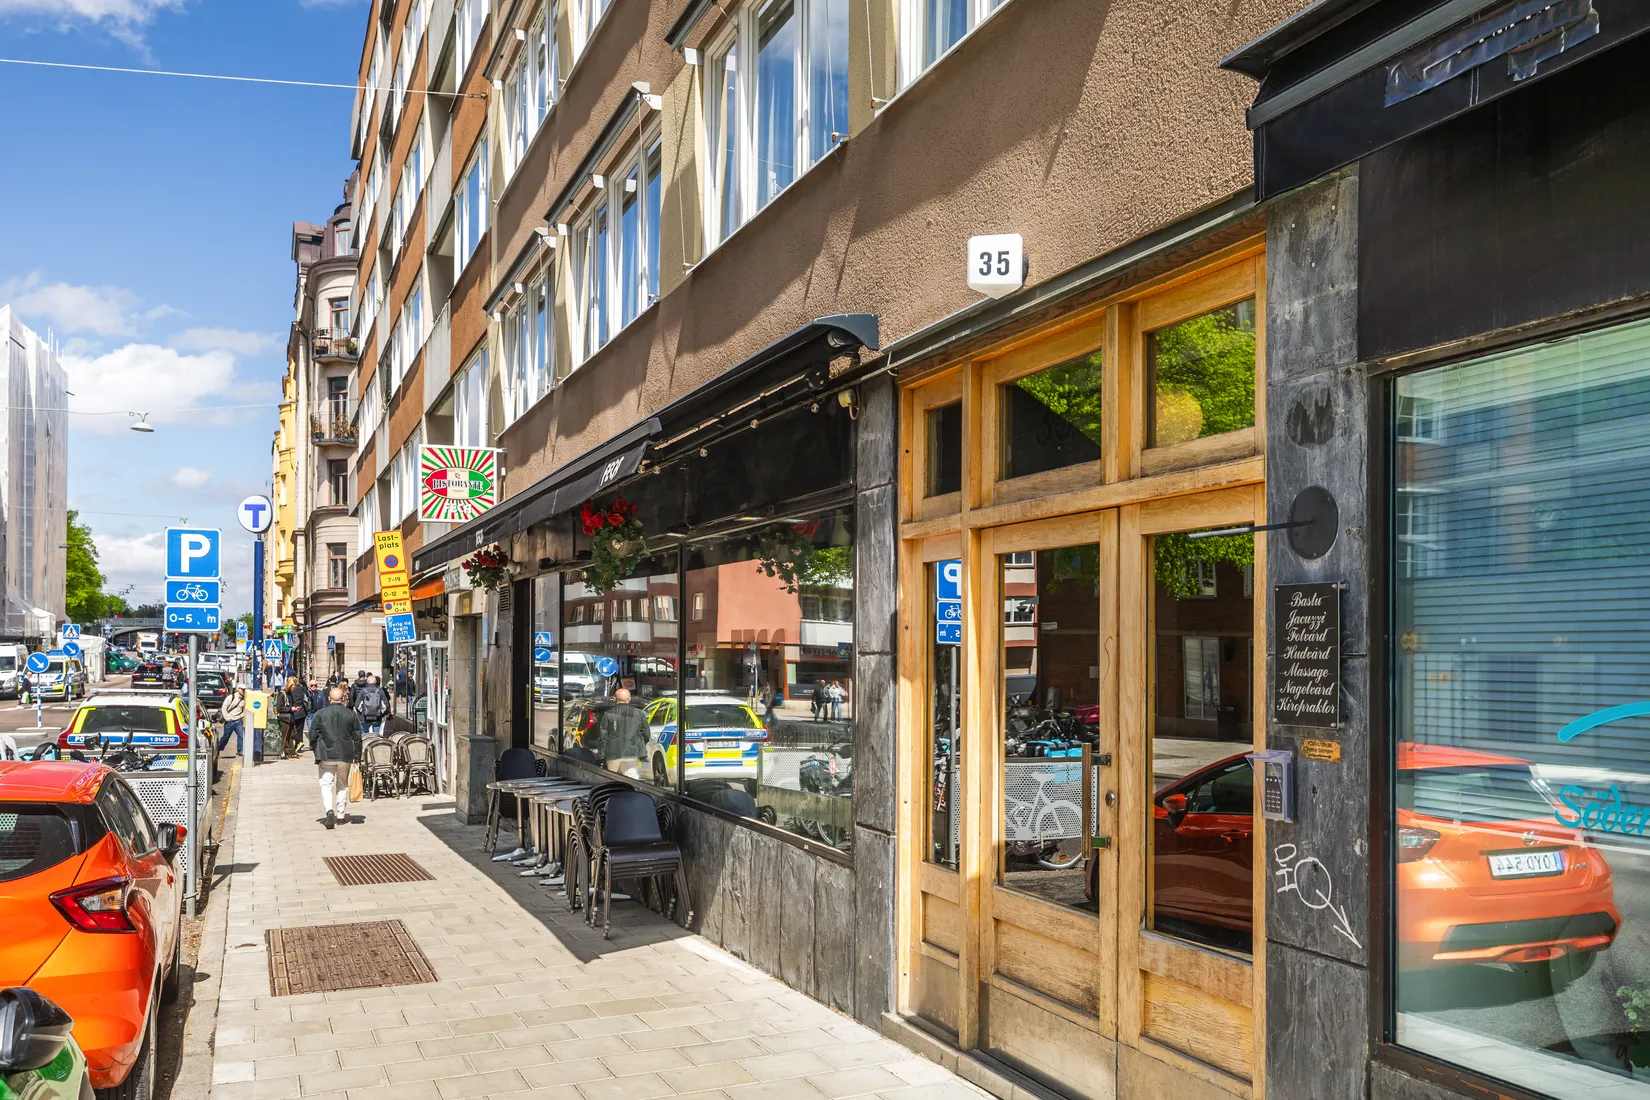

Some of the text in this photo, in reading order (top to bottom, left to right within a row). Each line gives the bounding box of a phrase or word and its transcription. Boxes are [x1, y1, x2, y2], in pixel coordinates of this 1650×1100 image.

[979, 251, 1010, 276] 35
[433, 479, 484, 491] RISTORANTE
[245, 504, 266, 528] T
[444, 503, 473, 514] FECA
[181, 534, 211, 573] P
[379, 542, 400, 551] plats
[1287, 592, 1328, 607] Bastu
[169, 613, 217, 623] 0-5 m
[1285, 610, 1328, 630] Jacuzzi
[1286, 627, 1332, 642] Fotvård
[1280, 645, 1334, 660] Hudvård
[1281, 662, 1331, 683] Massage
[1279, 680, 1335, 700] Nagelvård
[1277, 697, 1336, 716] Kiropraktor
